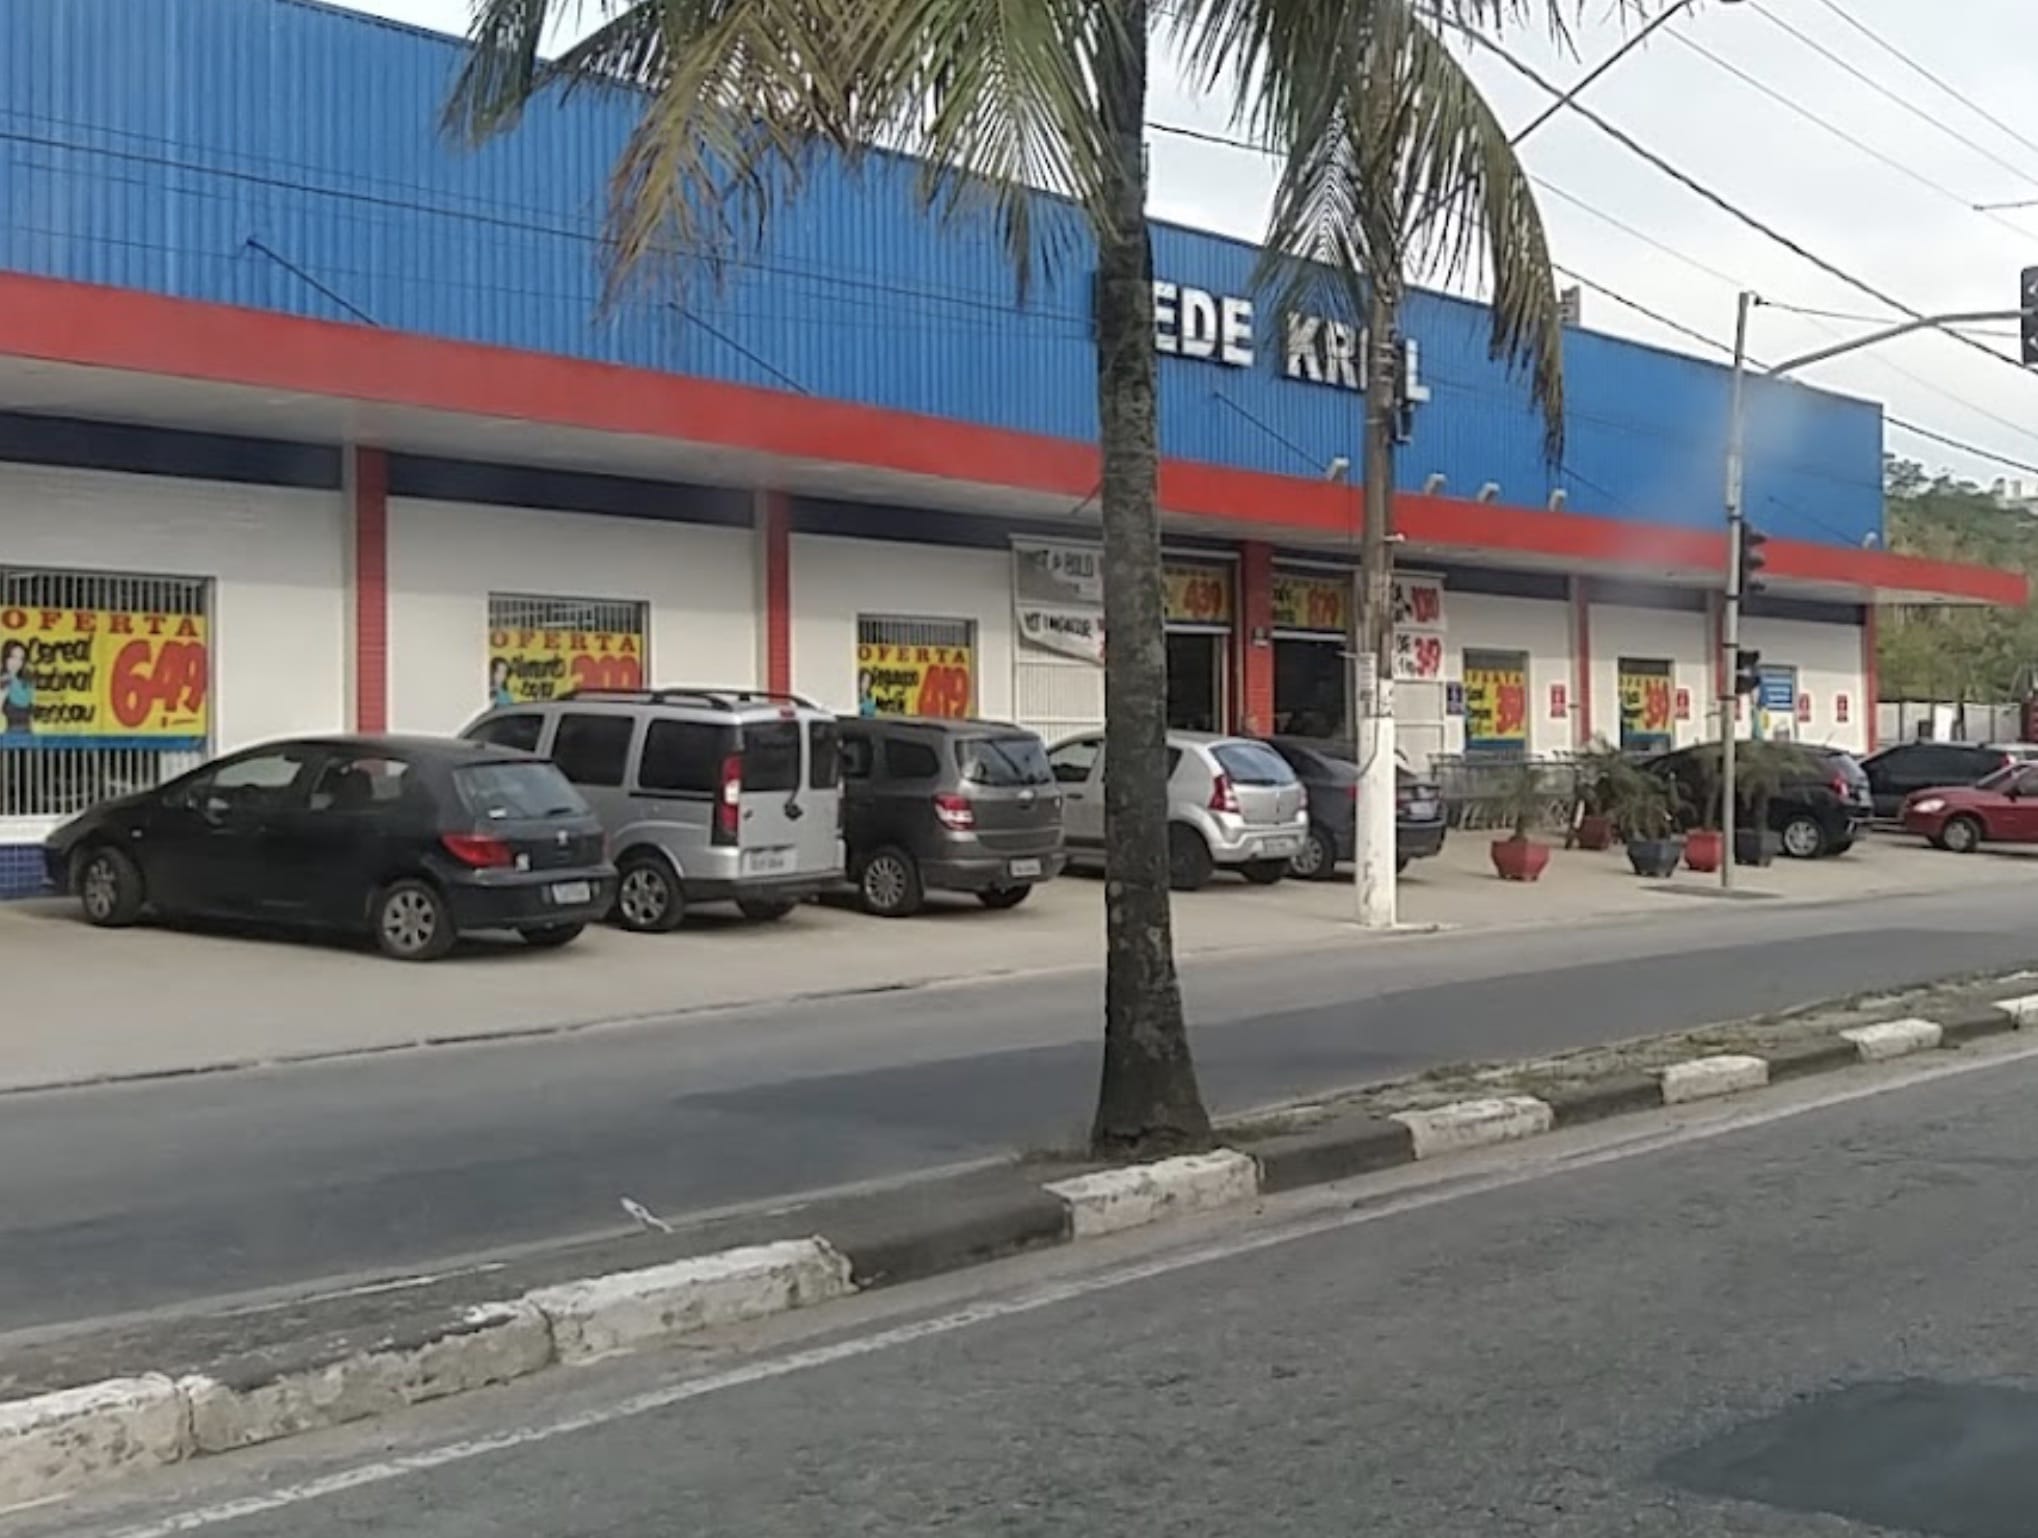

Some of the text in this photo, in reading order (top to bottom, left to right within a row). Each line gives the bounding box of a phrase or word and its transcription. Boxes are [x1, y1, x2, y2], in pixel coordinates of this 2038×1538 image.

[1153, 280, 1431, 403] EDE KRIL
[1, 608, 199, 637] OFERTA
[490, 630, 636, 652] OFERTA
[857, 646, 966, 663] OFERTA
